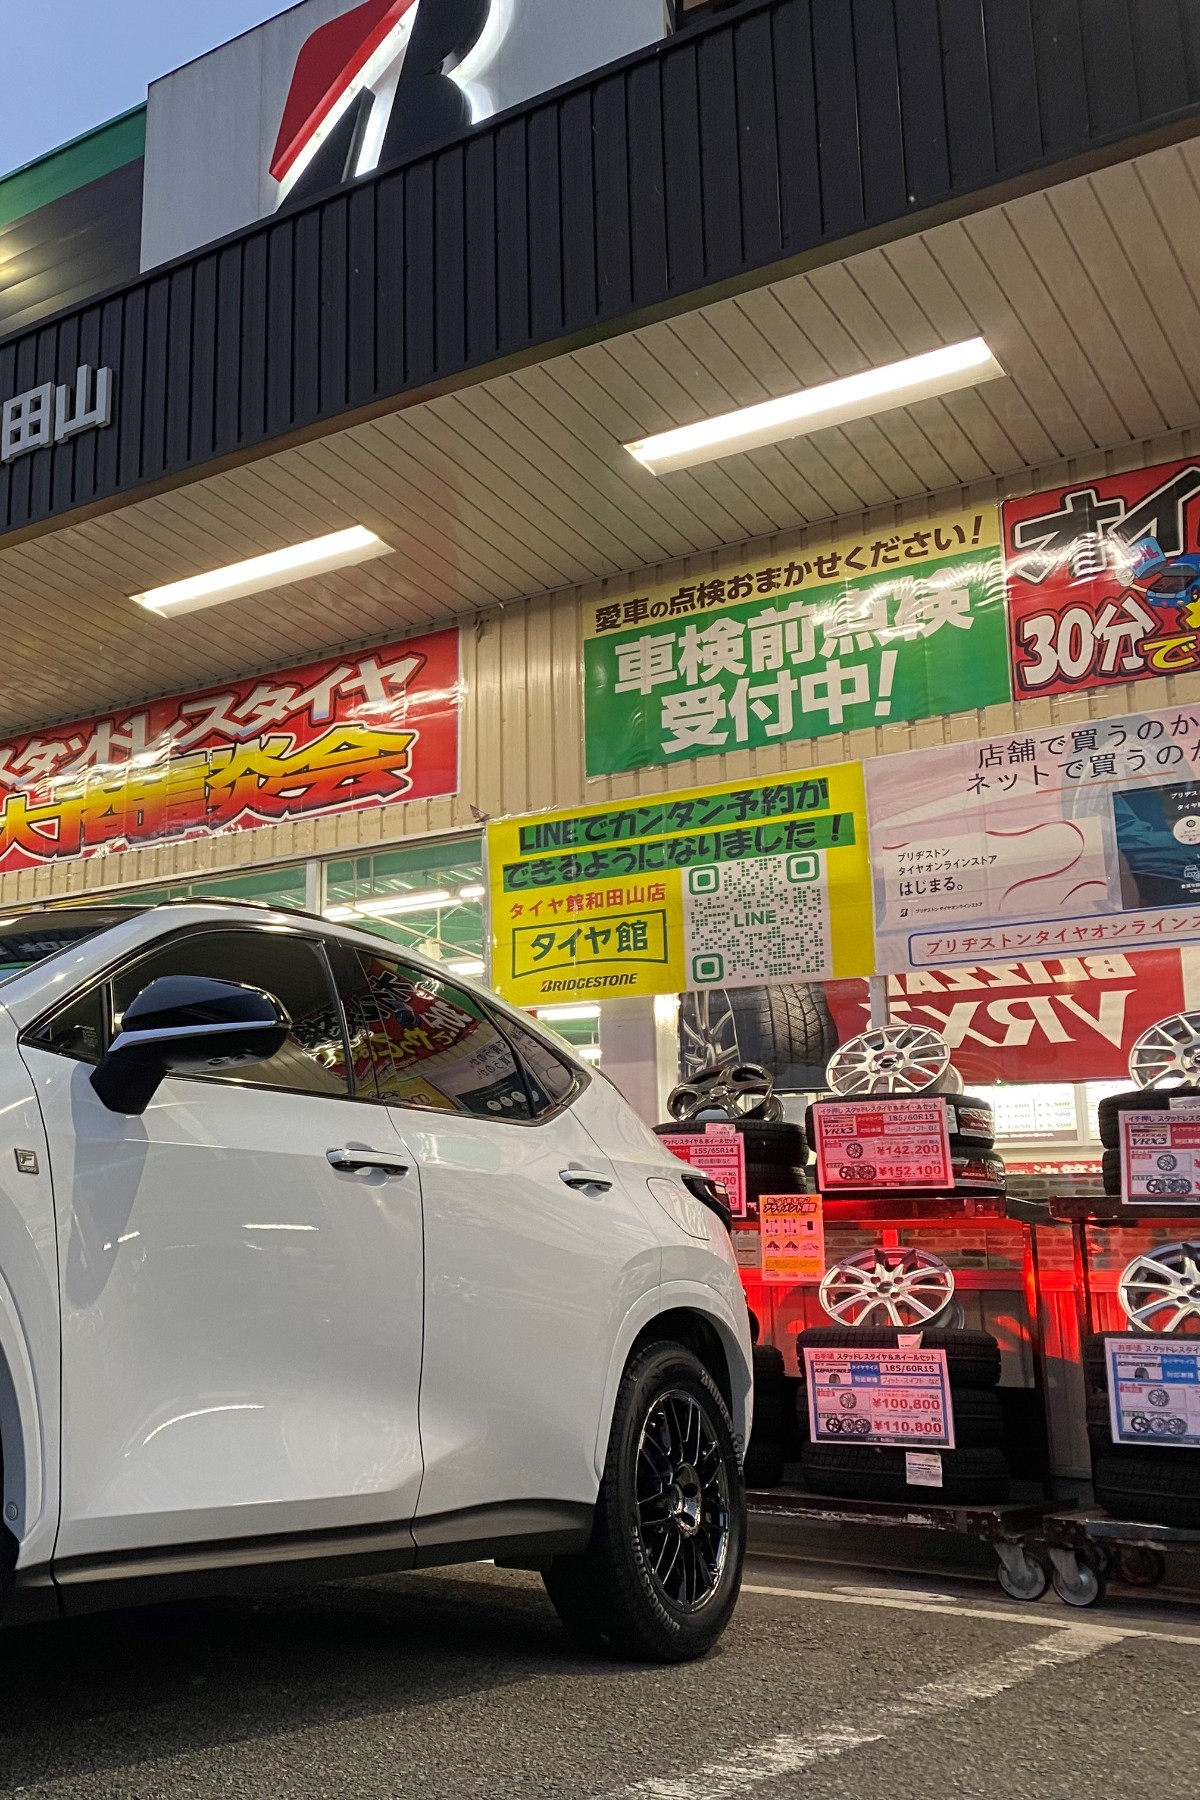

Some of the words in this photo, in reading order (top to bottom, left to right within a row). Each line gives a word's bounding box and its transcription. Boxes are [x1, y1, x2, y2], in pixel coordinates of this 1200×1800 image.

[596, 515, 982, 634] 愛車の点検おまかせください!
[615, 566, 974, 696] 車検前点検
[1022, 595, 1198, 686] 30分で
[661, 650, 897, 755] 受付中!
[979, 714, 1199, 768] 店舗で買うのか
[520, 777, 828, 852] LINEでカンタン予約が
[898, 849, 950, 863] ブリヂストン
[898, 855, 998, 875] タイヤオンラインストア
[899, 877, 964, 896] はじまる。
[510, 883, 666, 919] タイヤ館和田山店
[734, 910, 776, 927] LINE
[530, 921, 648, 961] タイヤ館
[540, 973, 638, 992] BRIDGESTONE
[888, 1113, 935, 1122] 185/60R15
[837, 1353, 936, 1361] スタッドレスタイヤ&ホイールセット
[885, 1364, 935, 1372] 185/60R15
[872, 1398, 940, 1410] ¥100,800
